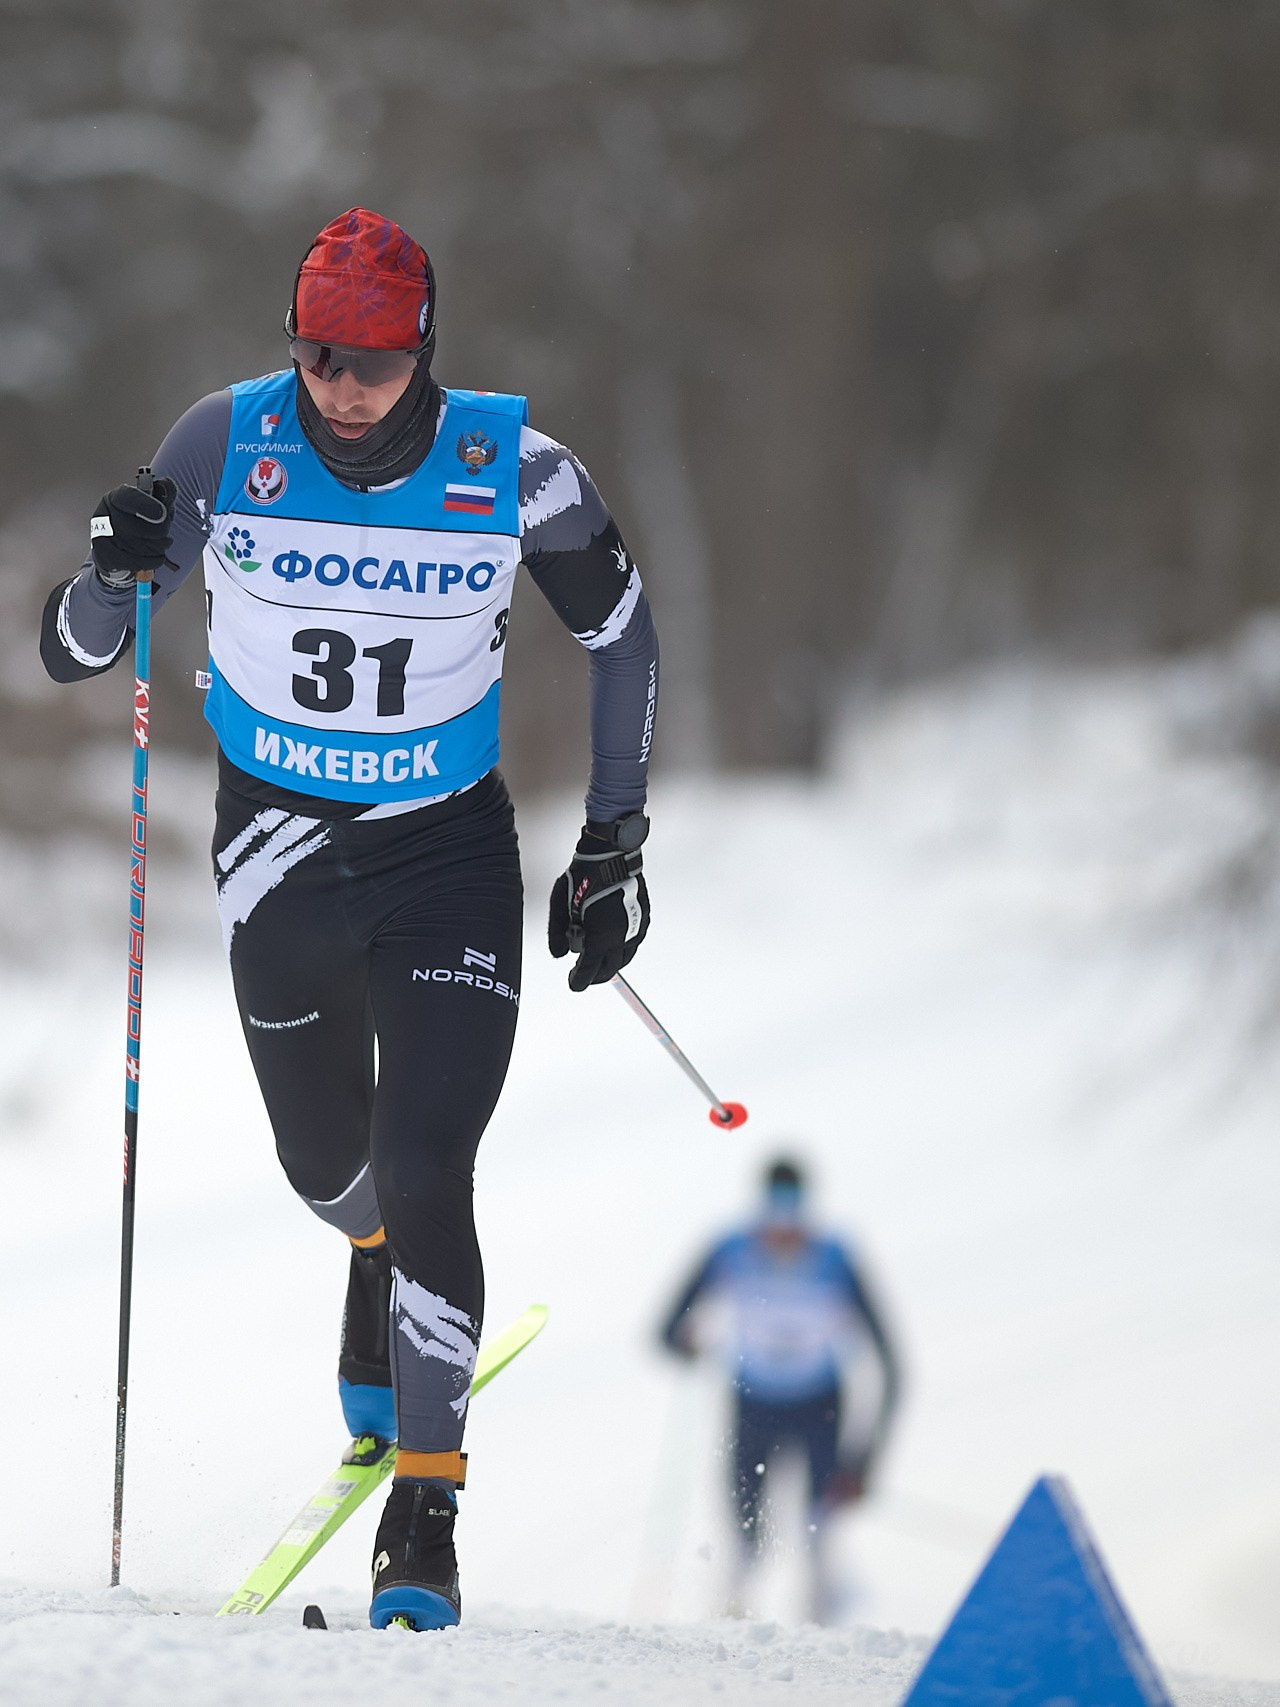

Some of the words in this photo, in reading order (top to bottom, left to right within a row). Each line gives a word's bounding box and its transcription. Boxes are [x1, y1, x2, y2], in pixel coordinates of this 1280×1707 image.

[272, 550, 496, 594] ФОСАГРО
[292, 628, 414, 717] 31
[638, 659, 656, 764] NORDSKI
[254, 726, 440, 783] ИЖЕВСК
[412, 968, 519, 1006] NORDSK
